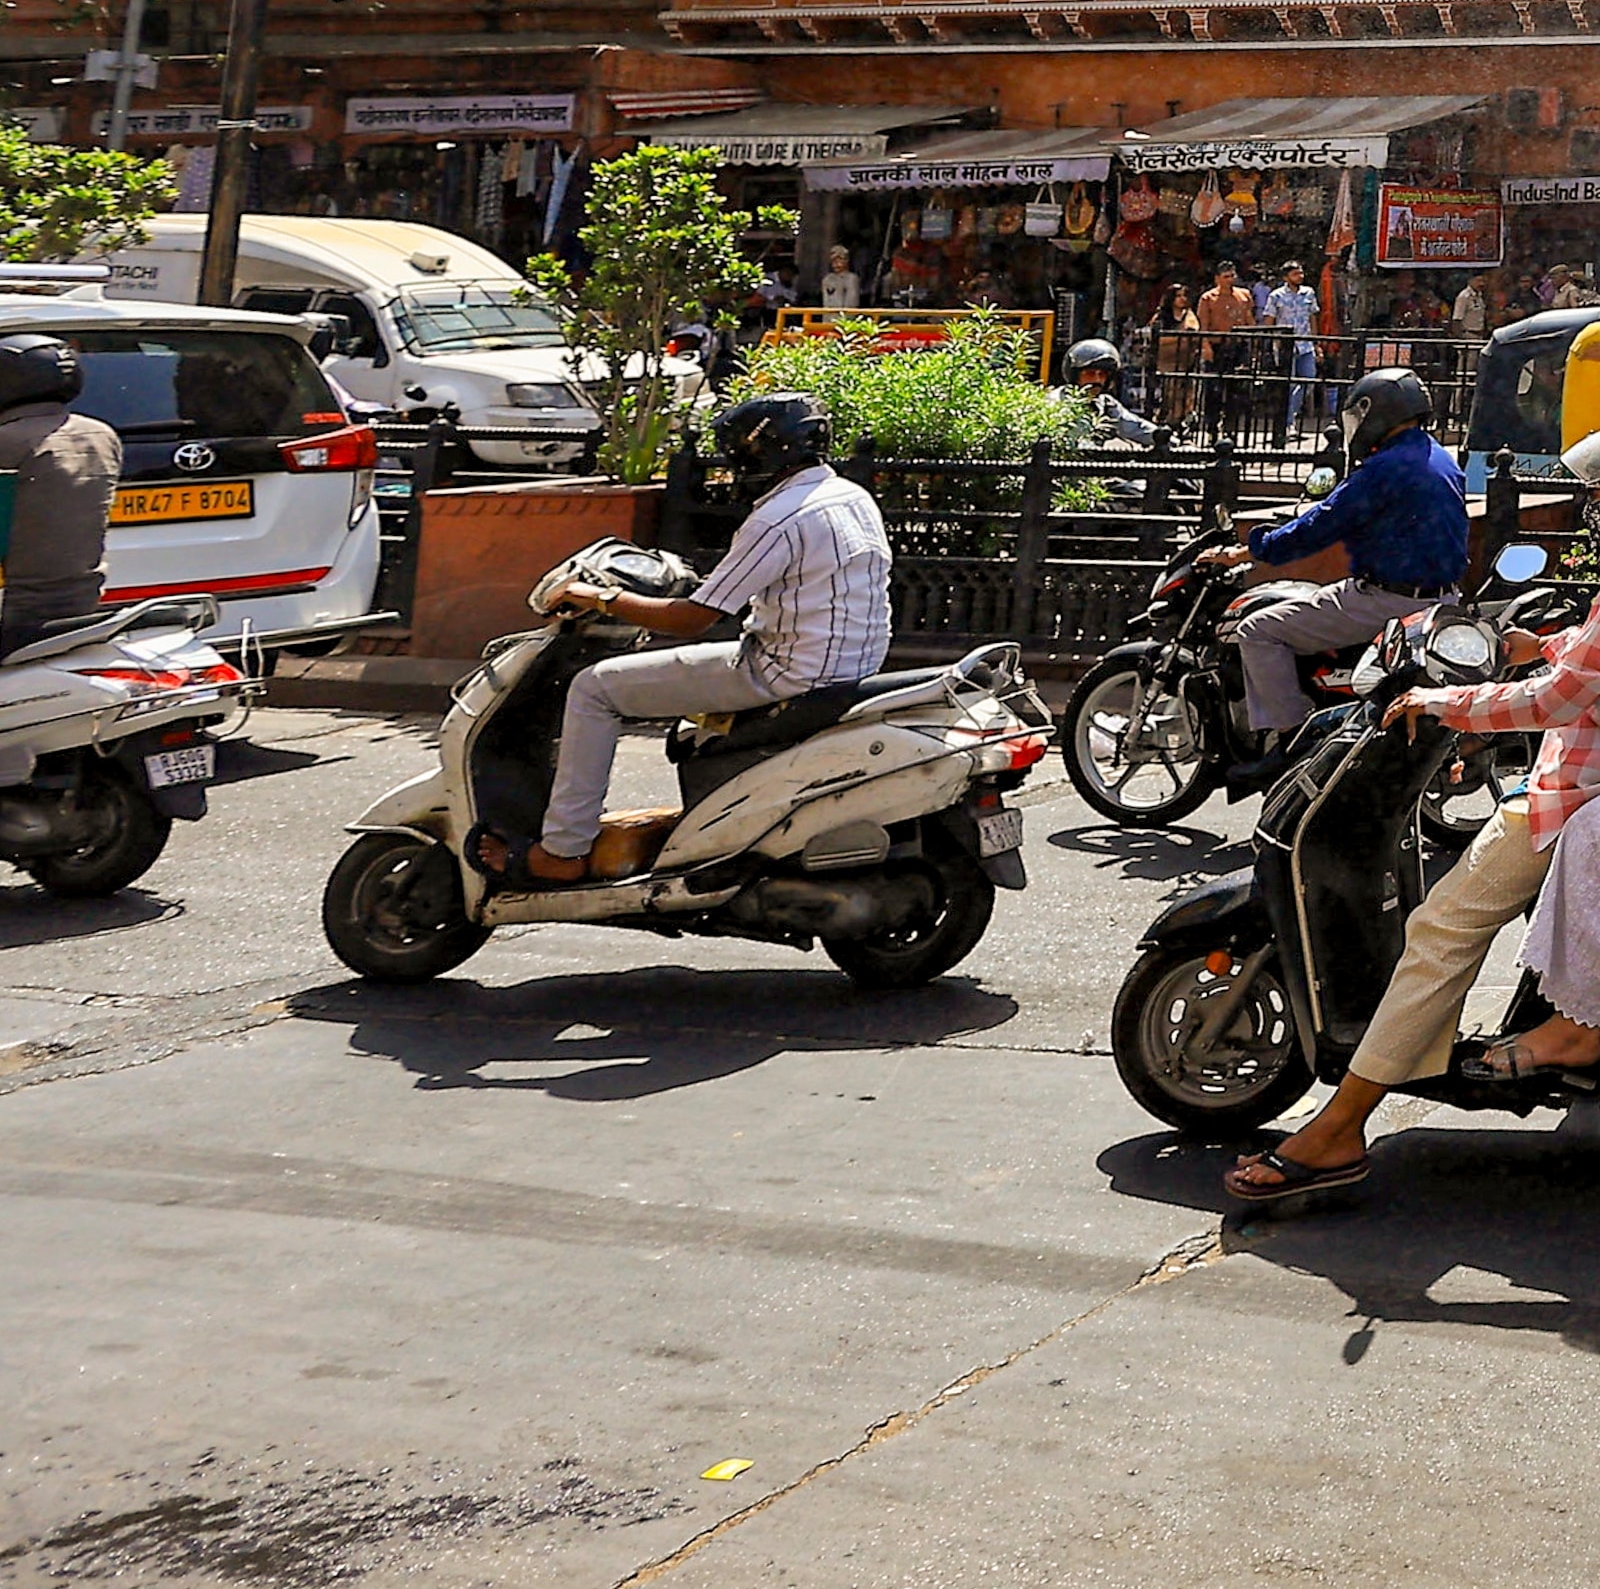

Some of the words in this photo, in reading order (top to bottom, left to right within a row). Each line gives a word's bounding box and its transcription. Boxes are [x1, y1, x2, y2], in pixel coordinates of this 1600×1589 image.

[1227, 143, 1359, 165] एक्सपोर्टर
[849, 166, 910, 185] जानकी
[918, 166, 957, 182] लाल
[961, 163, 1009, 182] मोहन
[1015, 163, 1053, 179] लाल
[1507, 182, 1580, 202] IndusInd
[111, 265, 158, 279] TACHI
[122, 493, 173, 516] HR47
[181, 493, 192, 510] F
[200, 488, 248, 510] 8704
